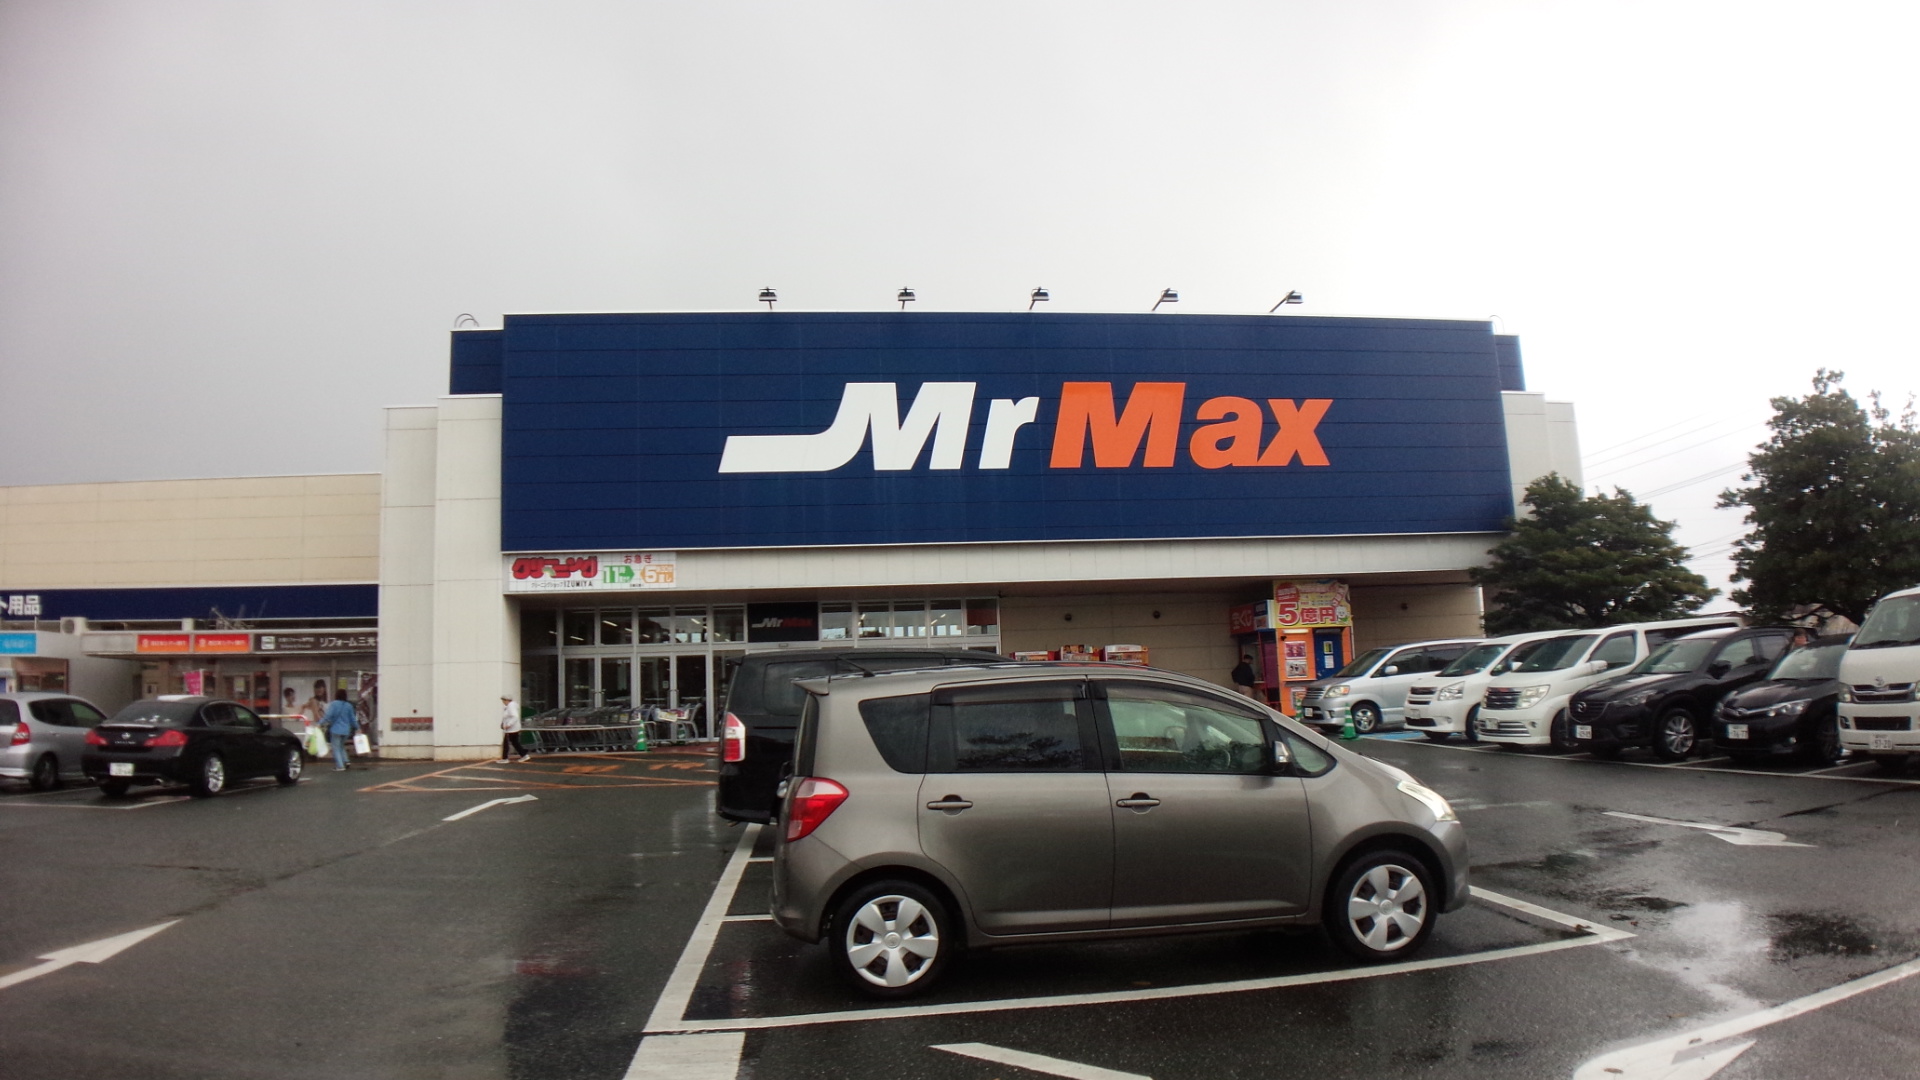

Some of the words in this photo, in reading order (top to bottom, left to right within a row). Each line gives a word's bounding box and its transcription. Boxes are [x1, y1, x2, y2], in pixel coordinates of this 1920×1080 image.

[1278, 602, 1338, 626] 5億円
[320, 637, 378, 647] リフォーム三光
